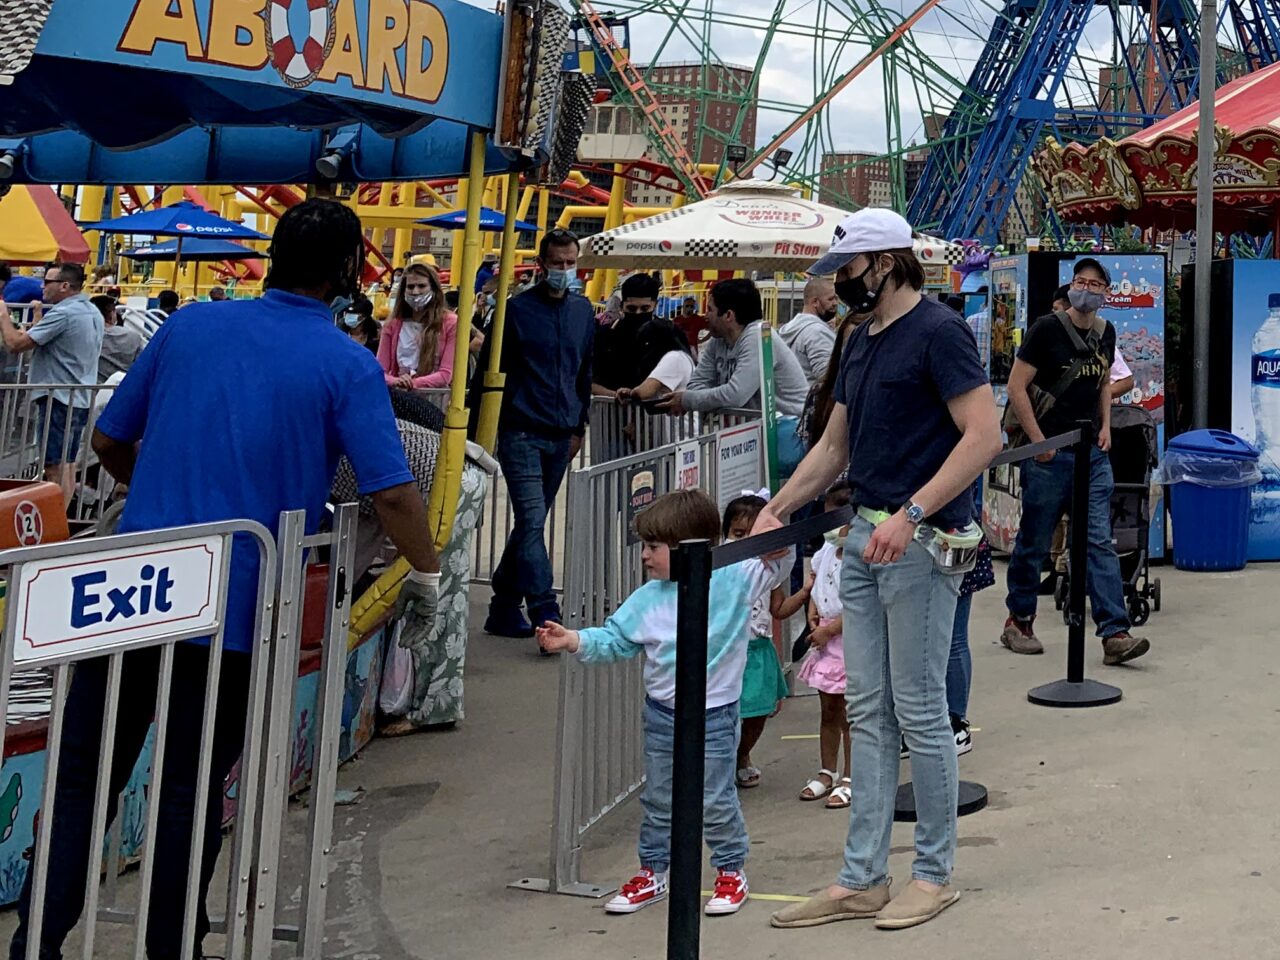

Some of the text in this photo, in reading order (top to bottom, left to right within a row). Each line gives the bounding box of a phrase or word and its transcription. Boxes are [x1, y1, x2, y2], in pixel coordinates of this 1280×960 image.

[735, 209, 802, 219] WONDER
[195, 225, 233, 235] pepsi
[626, 241, 656, 252] pepsi
[774, 241, 820, 258] Pit Stop
[720, 439, 757, 461] FOR YOUR SAFETY
[25, 516, 33, 533] 2
[70, 564, 175, 629] Exit
